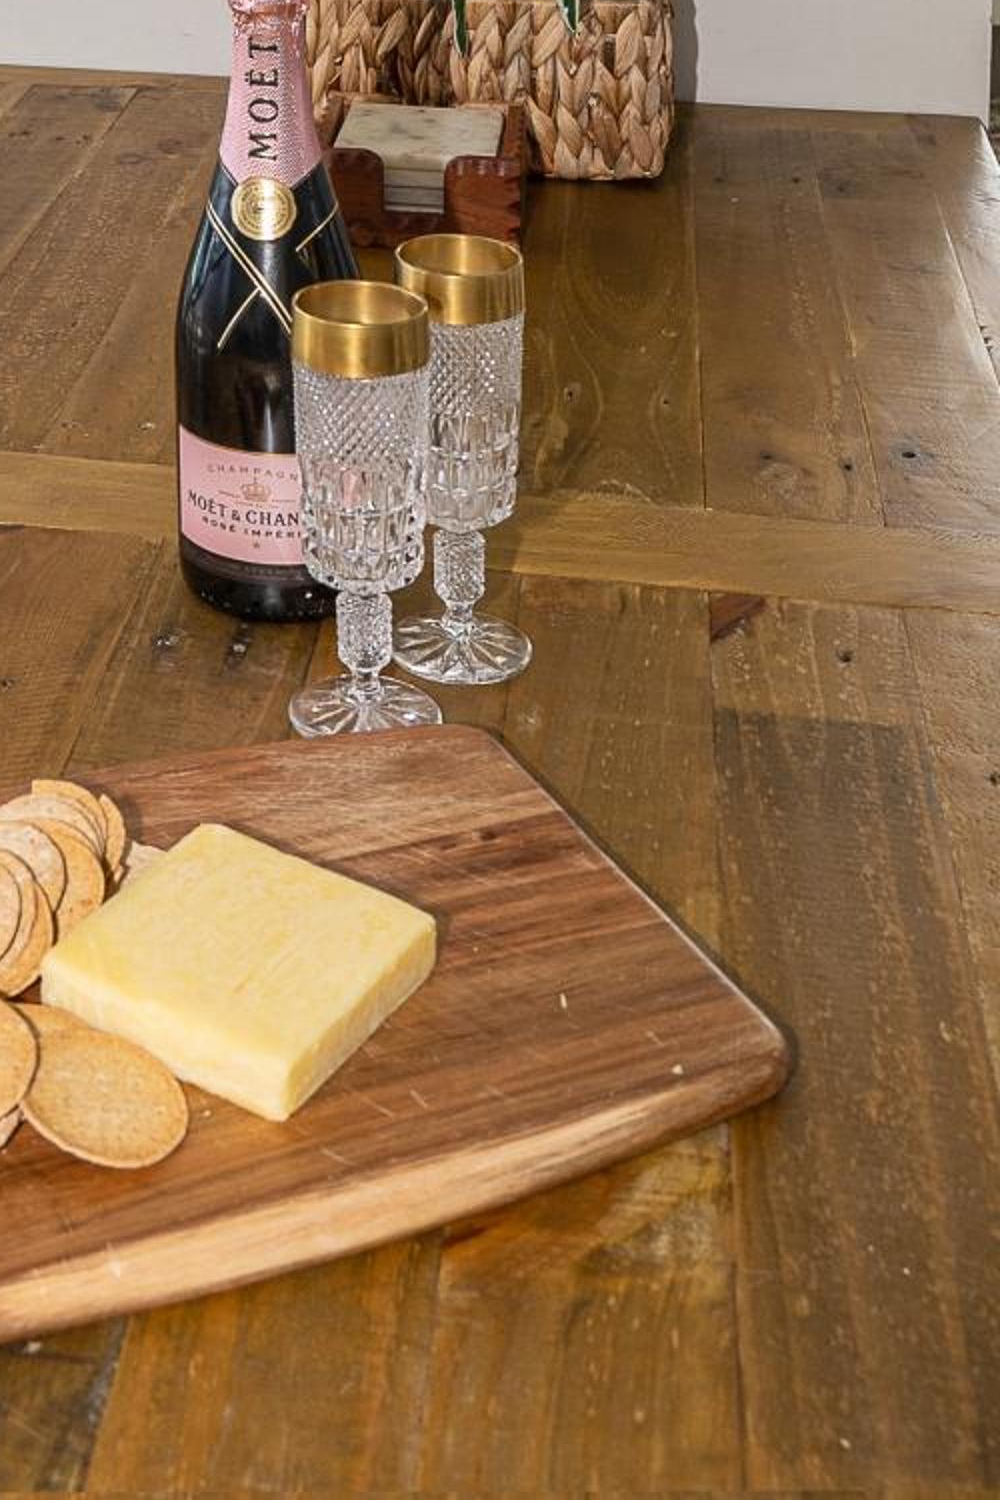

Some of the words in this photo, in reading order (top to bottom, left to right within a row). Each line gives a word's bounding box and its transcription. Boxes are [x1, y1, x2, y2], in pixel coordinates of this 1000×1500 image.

[245, 36, 280, 161] MOËT
[207, 463, 299, 482] CHAMPAGN
[231, 510, 241, 522] &
[245, 509, 300, 527] CHAN
[243, 528, 302, 539] IMPÉRI
